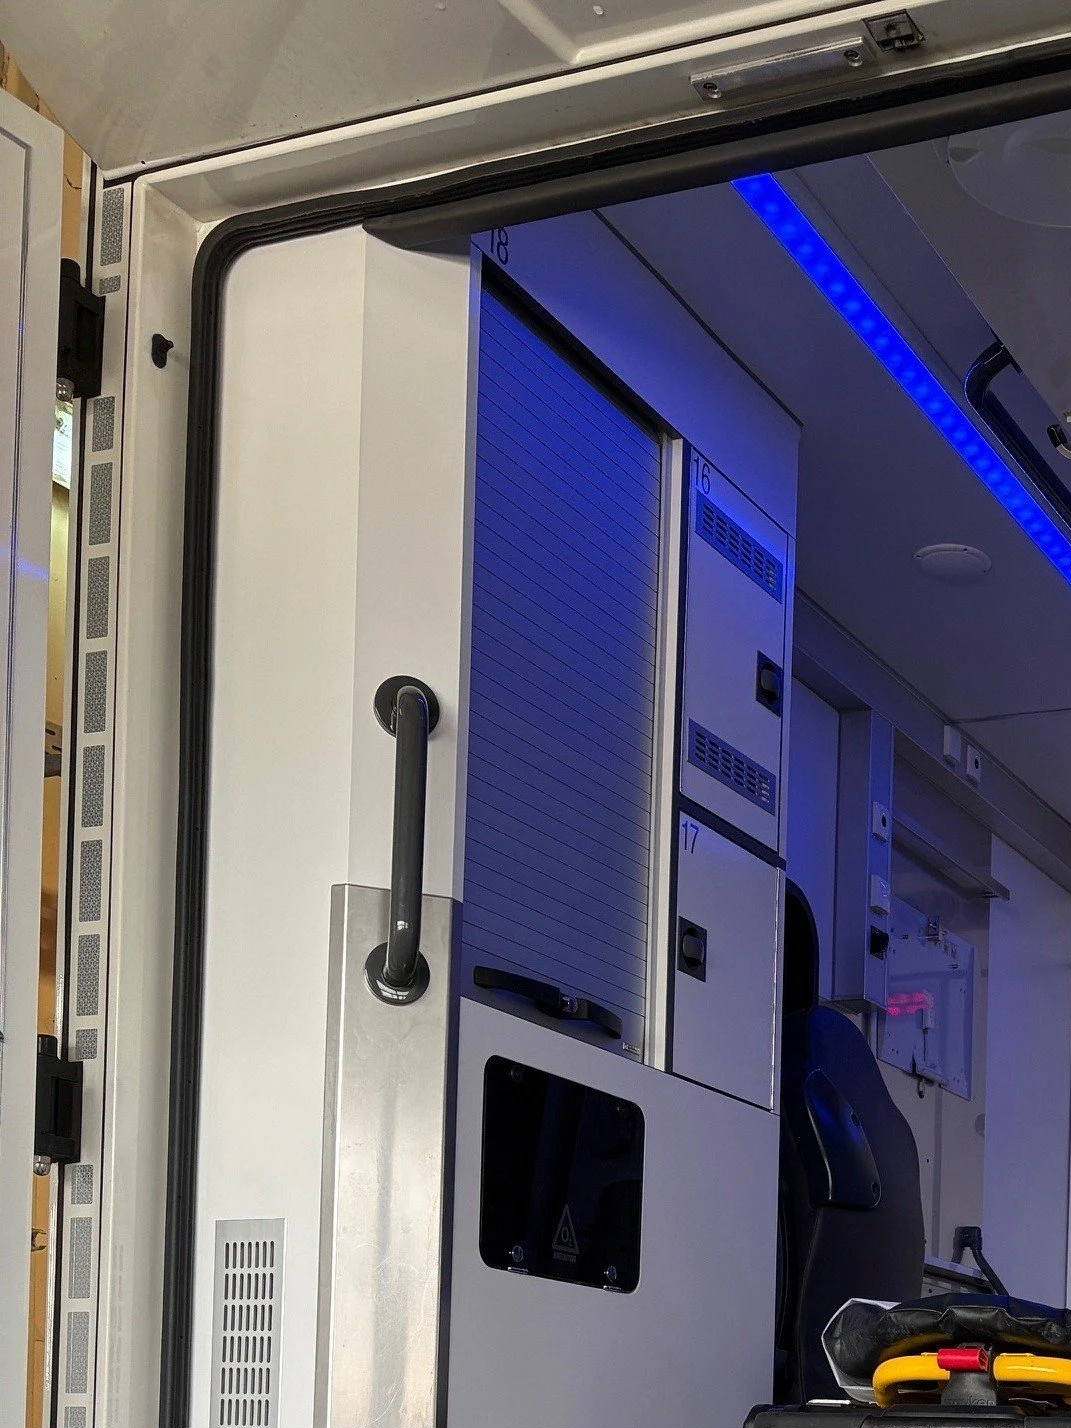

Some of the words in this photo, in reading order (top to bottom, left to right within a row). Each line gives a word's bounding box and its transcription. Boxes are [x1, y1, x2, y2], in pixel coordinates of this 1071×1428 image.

[490, 227, 508, 265] 18
[694, 456, 710, 495] 16
[682, 821, 699, 854] 17
